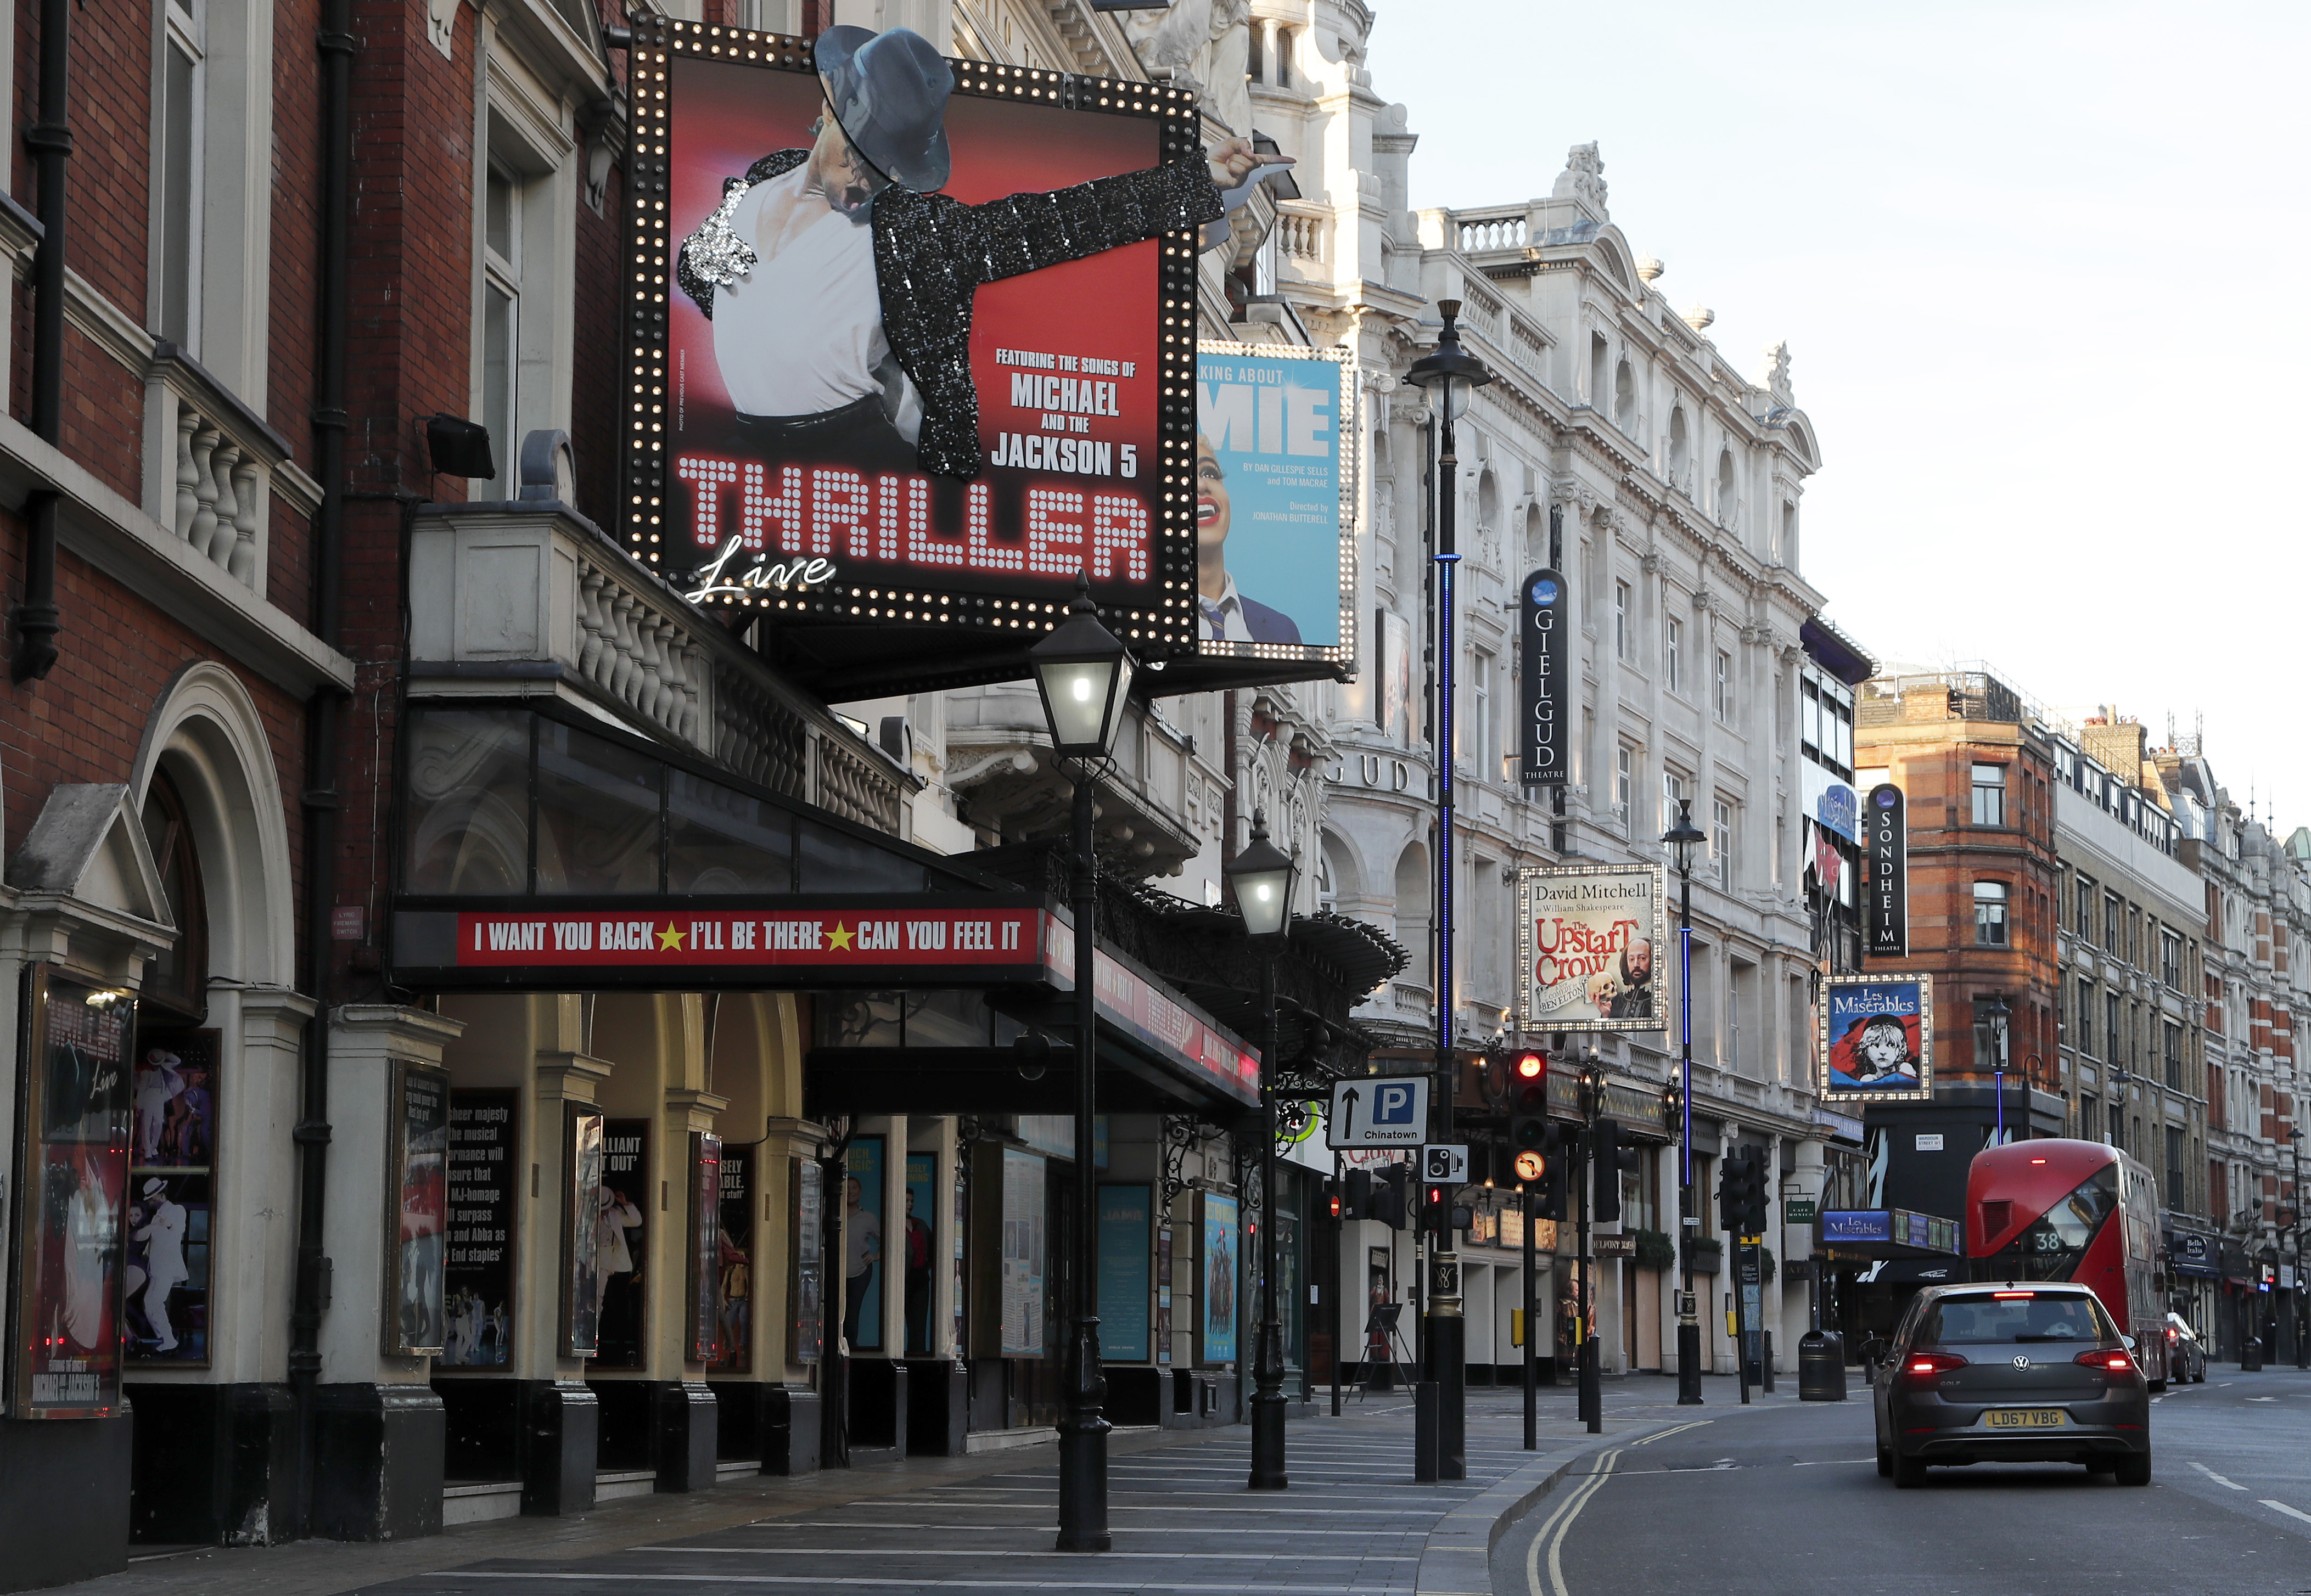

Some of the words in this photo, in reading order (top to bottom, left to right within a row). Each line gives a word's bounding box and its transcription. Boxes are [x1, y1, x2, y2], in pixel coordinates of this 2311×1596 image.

[996, 348, 1055, 369] FEATURING
[1058, 355, 1078, 372] THE
[1081, 357, 1119, 376] SONGS
[1122, 361, 1136, 378] OF
[1197, 365, 1233, 381] KING
[1238, 368, 1283, 384] ABOUT
[1011, 372, 1120, 417] MICHAEL
[1041, 413, 1066, 431] AND
[1069, 415, 1090, 433] THE
[1197, 382, 1329, 457] MIE
[991, 431, 1112, 476] JACKSON
[1120, 443, 1137, 479] 5
[1243, 463, 1252, 471] BY
[1255, 464, 1269, 473] DAN
[1271, 465, 1305, 474] GILLESPIE
[1307, 467, 1328, 476] SELLS
[1267, 477, 1280, 485] and
[1282, 478, 1297, 486] TOM
[1299, 479, 1328, 487] MACRAE
[1290, 502, 1319, 512] Directed
[1320, 504, 1328, 513] by
[678, 457, 1148, 581] THRILLER
[1252, 512, 1287, 521] JONATHAN
[1289, 514, 1328, 524] BUTTERELL
[686, 534, 837, 604] Live
[1534, 609, 1555, 767] GIELGUD
[1524, 769, 1564, 779] THEATRE
[1880, 812, 1894, 942] SONDHEIM
[1535, 885, 1577, 901] David
[1581, 883, 1647, 900] Mitchell
[1543, 904, 1574, 913] William
[1576, 903, 1624, 913] Shakespeare
[1572, 921, 1588, 930] The
[475, 923, 481, 951] I
[489, 923, 547, 951] WANT
[552, 923, 593, 951] YOU
[599, 922, 654, 951] BACK
[691, 921, 724, 950] I'LL
[732, 921, 755, 950] BE
[763, 921, 822, 950] THERE
[857, 921, 899, 950] CAN
[906, 921, 946, 950] YOU
[953, 921, 994, 950] FEEL
[1002, 921, 1021, 950] IT
[1536, 954, 1610, 986] Crow
[1541, 999, 1559, 1010] BEN
[1558, 987, 1583, 1005] ELTON
[1549, 984, 1573, 999] COMEDY
[1863, 988, 1882, 1001] Les
[1835, 996, 1914, 1014] Misérables
[89, 1060, 118, 1099] Live
[1382, 1088, 1407, 1120] P
[450, 1108, 472, 1121] sheer
[475, 1107, 508, 1123] majesty
[464, 1127, 497, 1141] musical
[1365, 1131, 1417, 1139] Chinatown
[488, 1147, 503, 1161] will
[474, 1167, 491, 1181] that
[451, 1188, 500, 1203] MJ-homage
[457, 1210, 492, 1224] surpass
[1103, 1210, 1145, 1222] JAMIE
[1849, 1217, 1861, 1226] Les
[454, 1228, 469, 1242] and
[472, 1228, 493, 1241] Abba
[495, 1229, 505, 1241] as
[2036, 1233, 2060, 1250] 38
[452, 1248, 465, 1262] End
[469, 1247, 502, 1263] staples'
[33, 1374, 59, 1402] MICHAEL
[66, 1374, 95, 1401] JACKSON
[96, 1374, 100, 1401] 5
[1993, 1413, 2027, 1425] LD67
[2032, 1412, 2058, 1424] VBG
